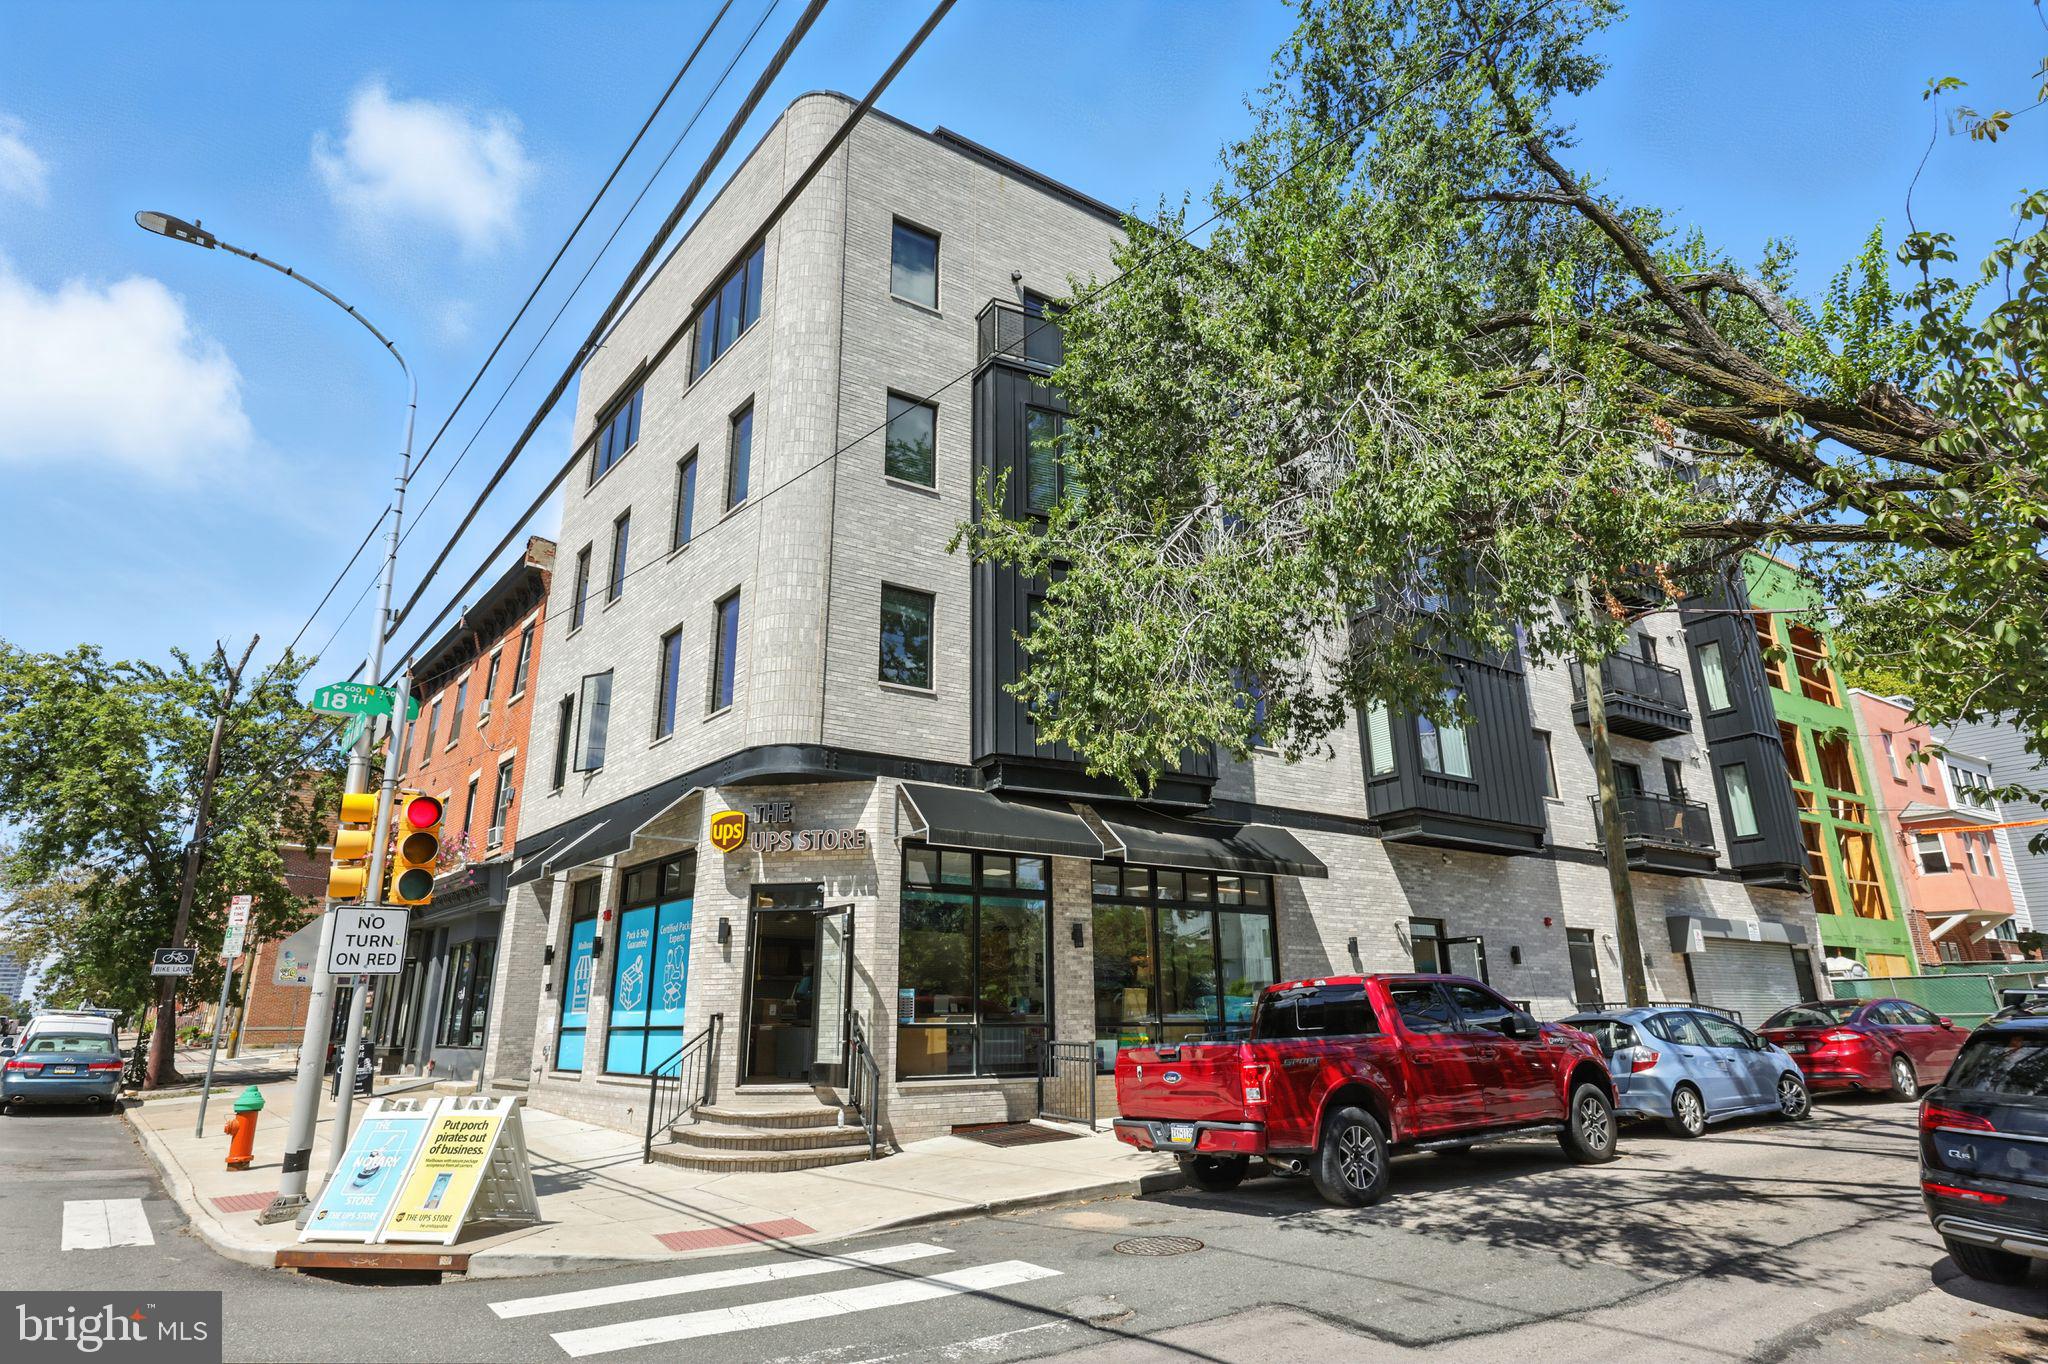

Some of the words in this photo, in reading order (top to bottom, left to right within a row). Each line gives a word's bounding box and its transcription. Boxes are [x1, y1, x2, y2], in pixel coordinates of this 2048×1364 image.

[365, 687, 376, 696] N
[321, 691, 348, 709] 18
[352, 694, 368, 705] TH
[752, 802, 791, 824] THE
[712, 822, 743, 846] ups
[751, 830, 793, 852] UPS
[798, 828, 867, 850] STORE
[358, 916, 385, 929] NO
[345, 934, 394, 947] TURN
[626, 930, 636, 940] Pack
[640, 928, 650, 939] Ship
[669, 933, 686, 944] Experts
[336, 952, 360, 966] ON
[366, 952, 397, 966] RED
[442, 1119, 460, 1130] Put
[460, 1120, 489, 1132] porch
[434, 1132, 468, 1144] pirates
[469, 1133, 487, 1143] out
[429, 1143, 441, 1154] of
[441, 1144, 484, 1155] business.
[345, 1196, 377, 1206] STORE
[405, 1213, 417, 1221] THE
[418, 1213, 432, 1222] UPS
[432, 1214, 453, 1222] STORE
